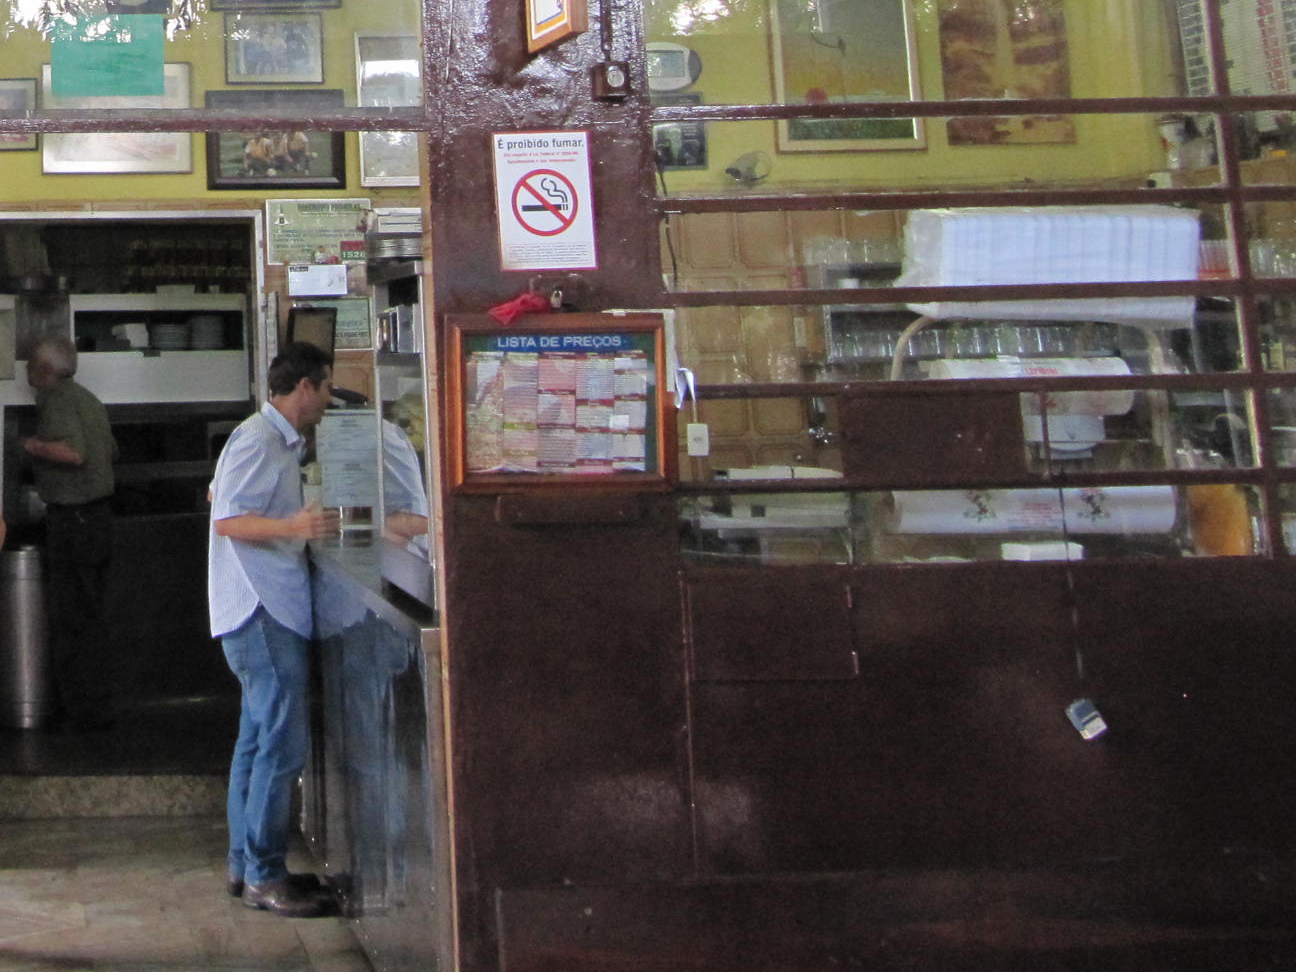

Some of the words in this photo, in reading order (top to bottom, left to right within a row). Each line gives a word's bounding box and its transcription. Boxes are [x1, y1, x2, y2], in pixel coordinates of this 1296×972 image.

[497, 138, 505, 149] É
[507, 139, 550, 150] proibido
[552, 138, 585, 148] fumar.
[497, 336, 537, 348] LISTA
[540, 336, 561, 347] DE
[563, 335, 622, 349] PREÇOS
